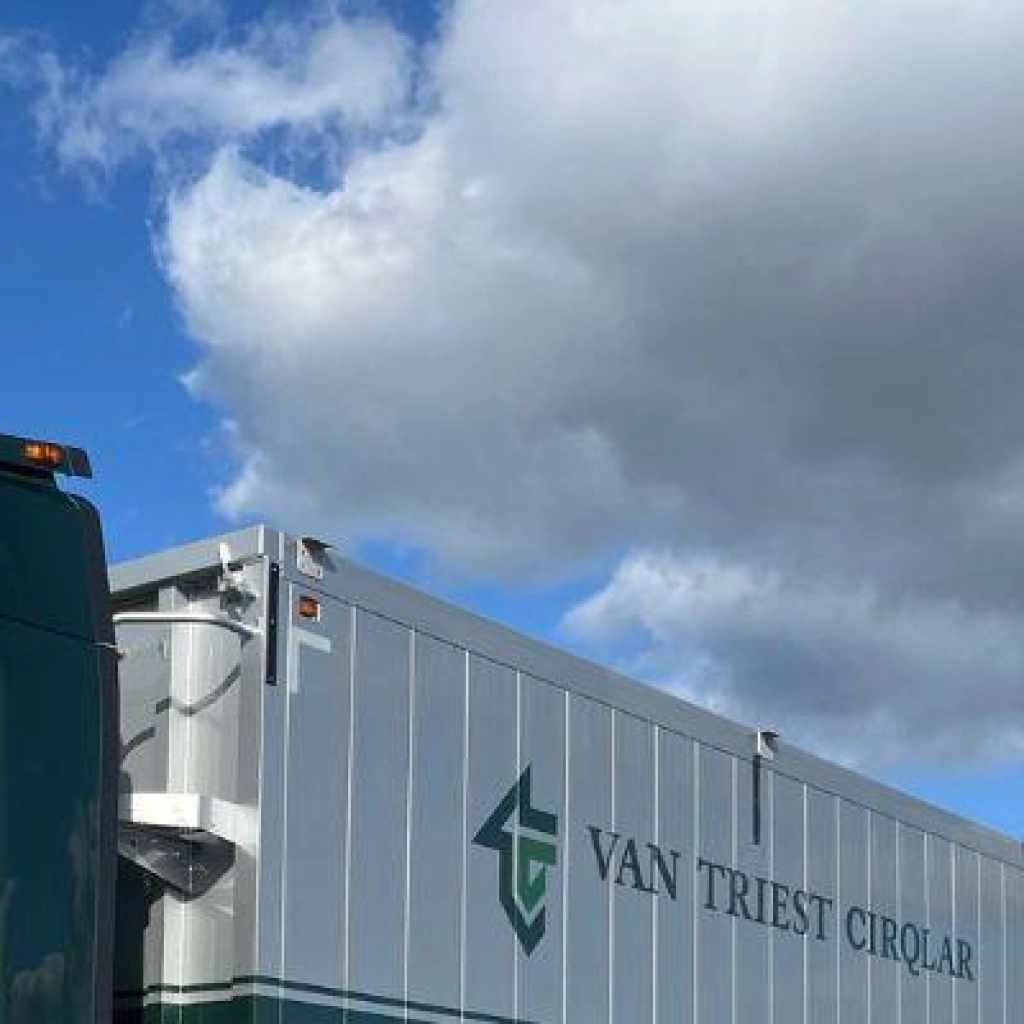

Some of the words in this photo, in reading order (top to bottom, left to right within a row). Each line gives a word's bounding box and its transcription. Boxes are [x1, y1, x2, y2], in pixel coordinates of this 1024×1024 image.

[587, 824, 681, 900] VAN
[697, 857, 833, 941] TRIEST
[846, 905, 975, 981] CIRQLAR
